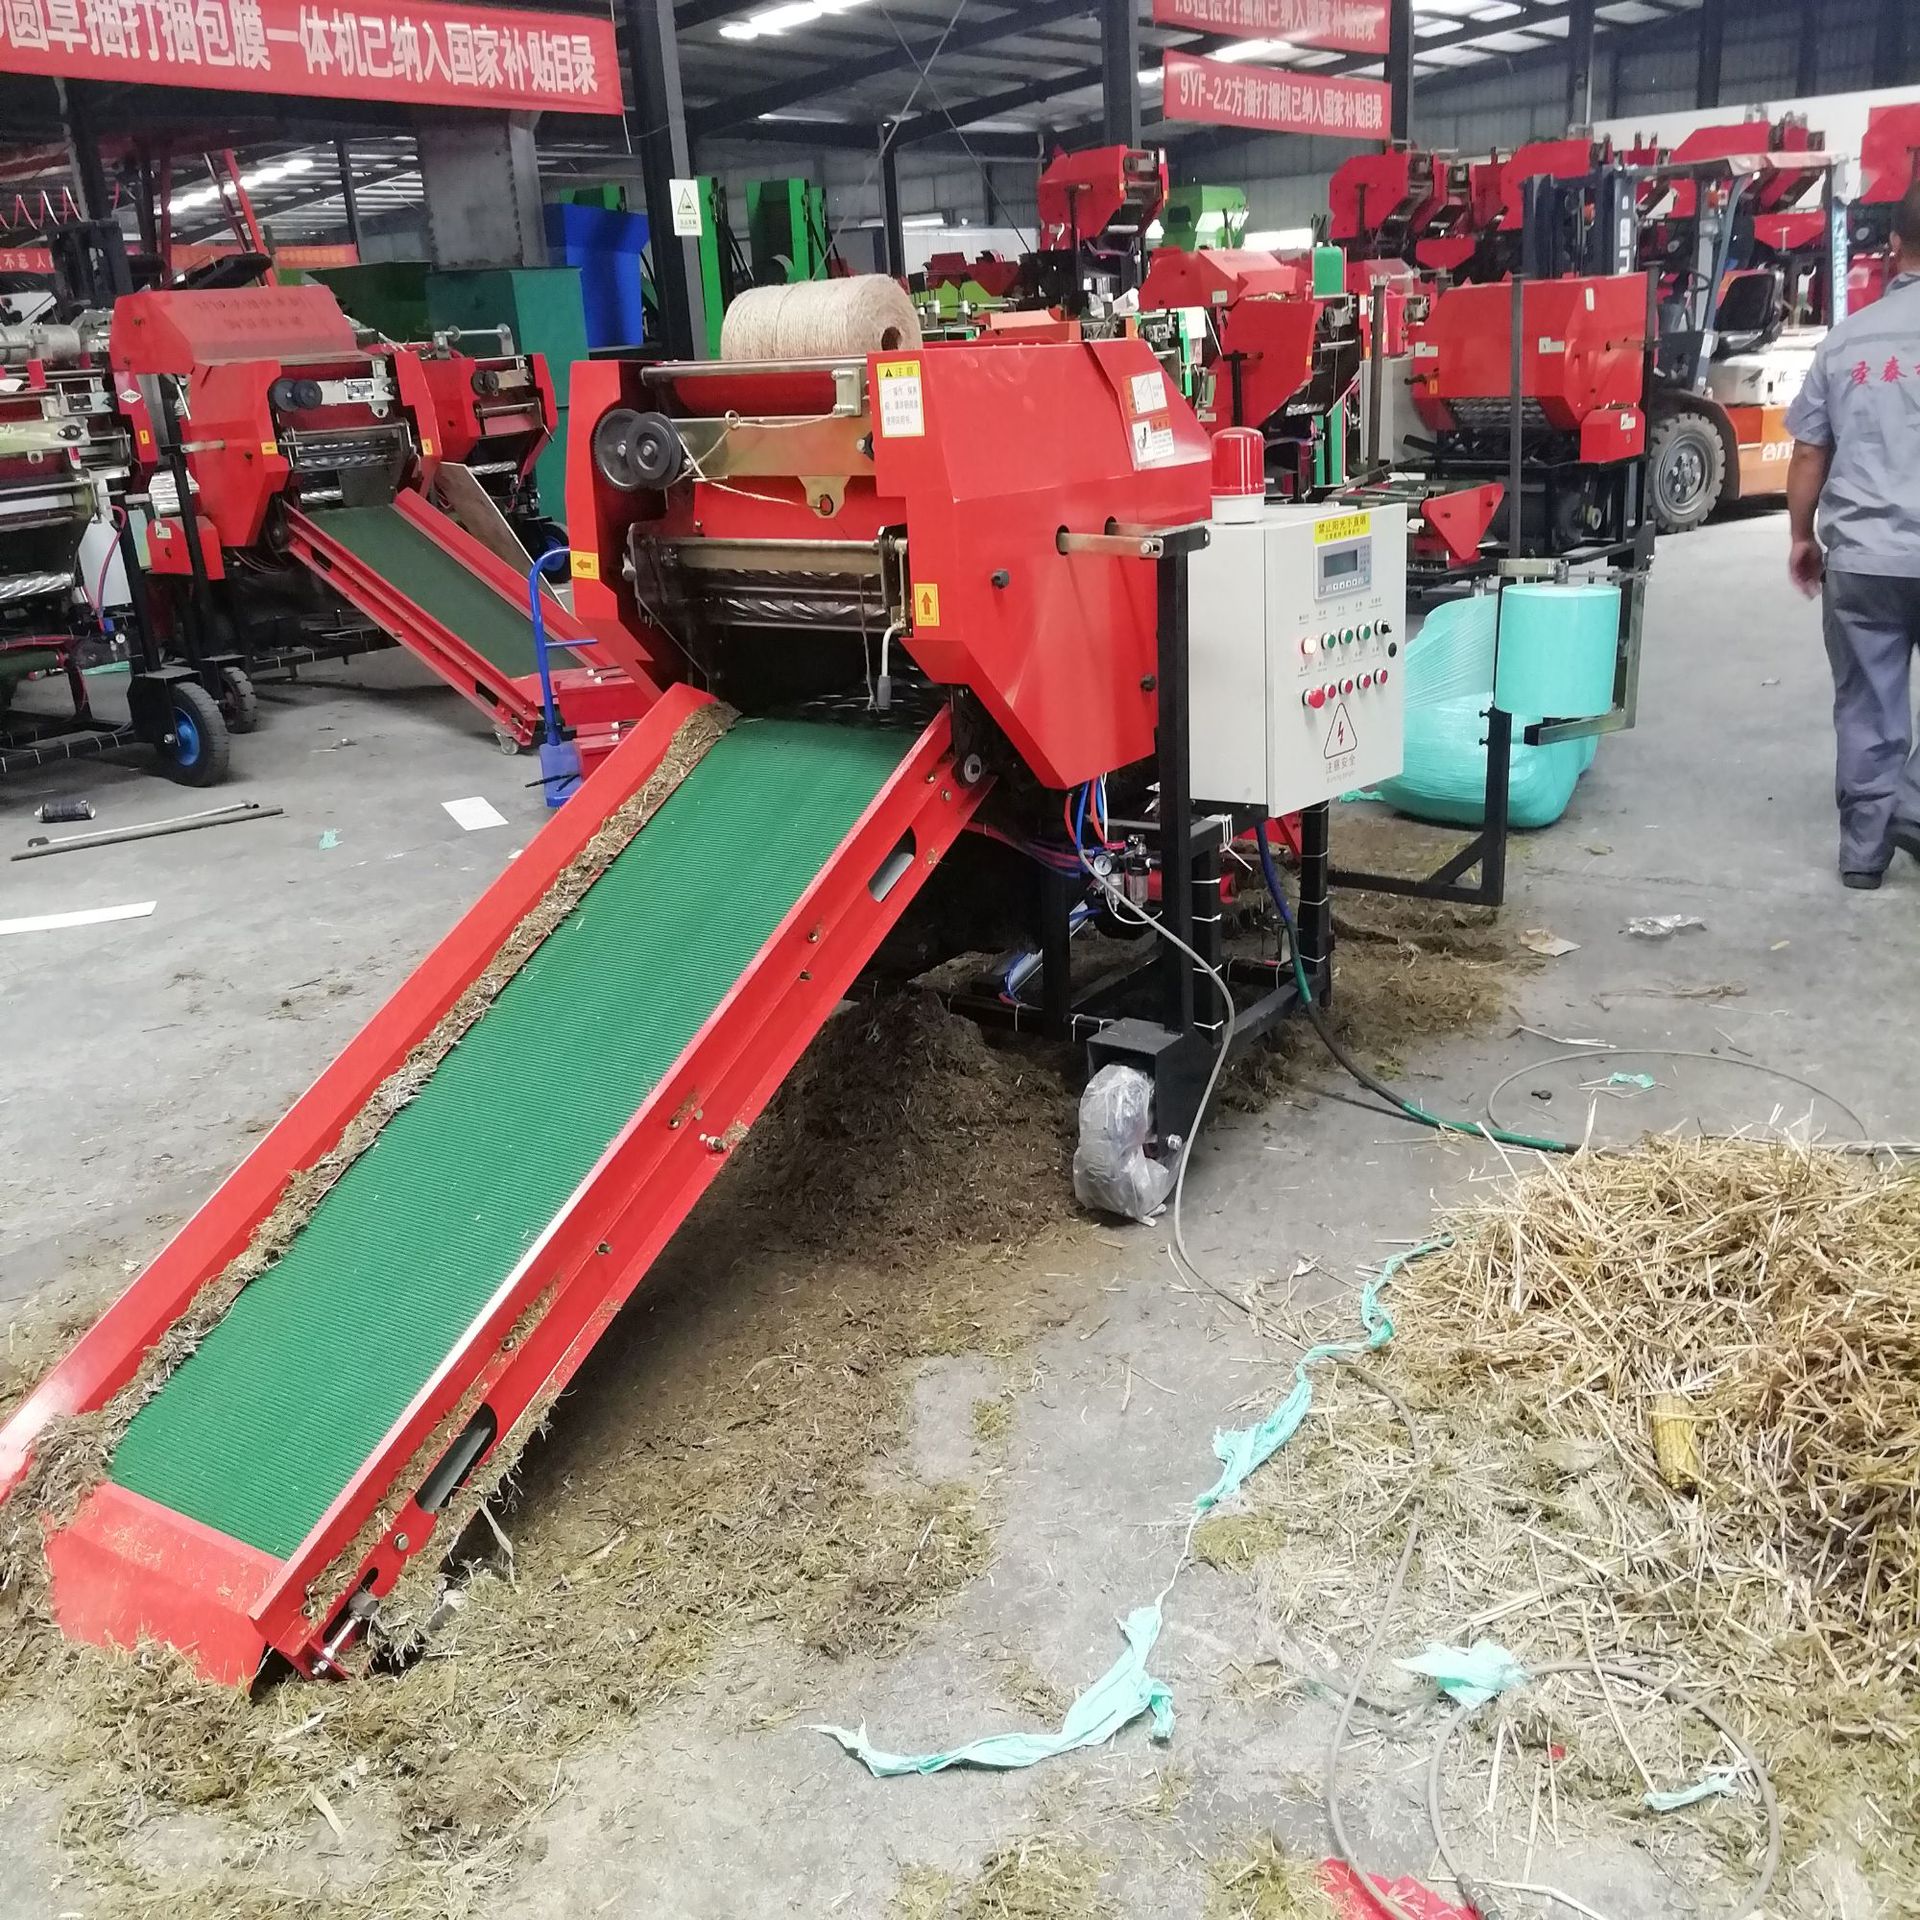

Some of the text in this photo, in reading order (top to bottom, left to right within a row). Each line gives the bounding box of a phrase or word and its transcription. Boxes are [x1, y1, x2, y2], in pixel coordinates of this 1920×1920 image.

[1180, 71, 1383, 129] 9YF-2.2方捆打捆机已纳入国家补贴目录
